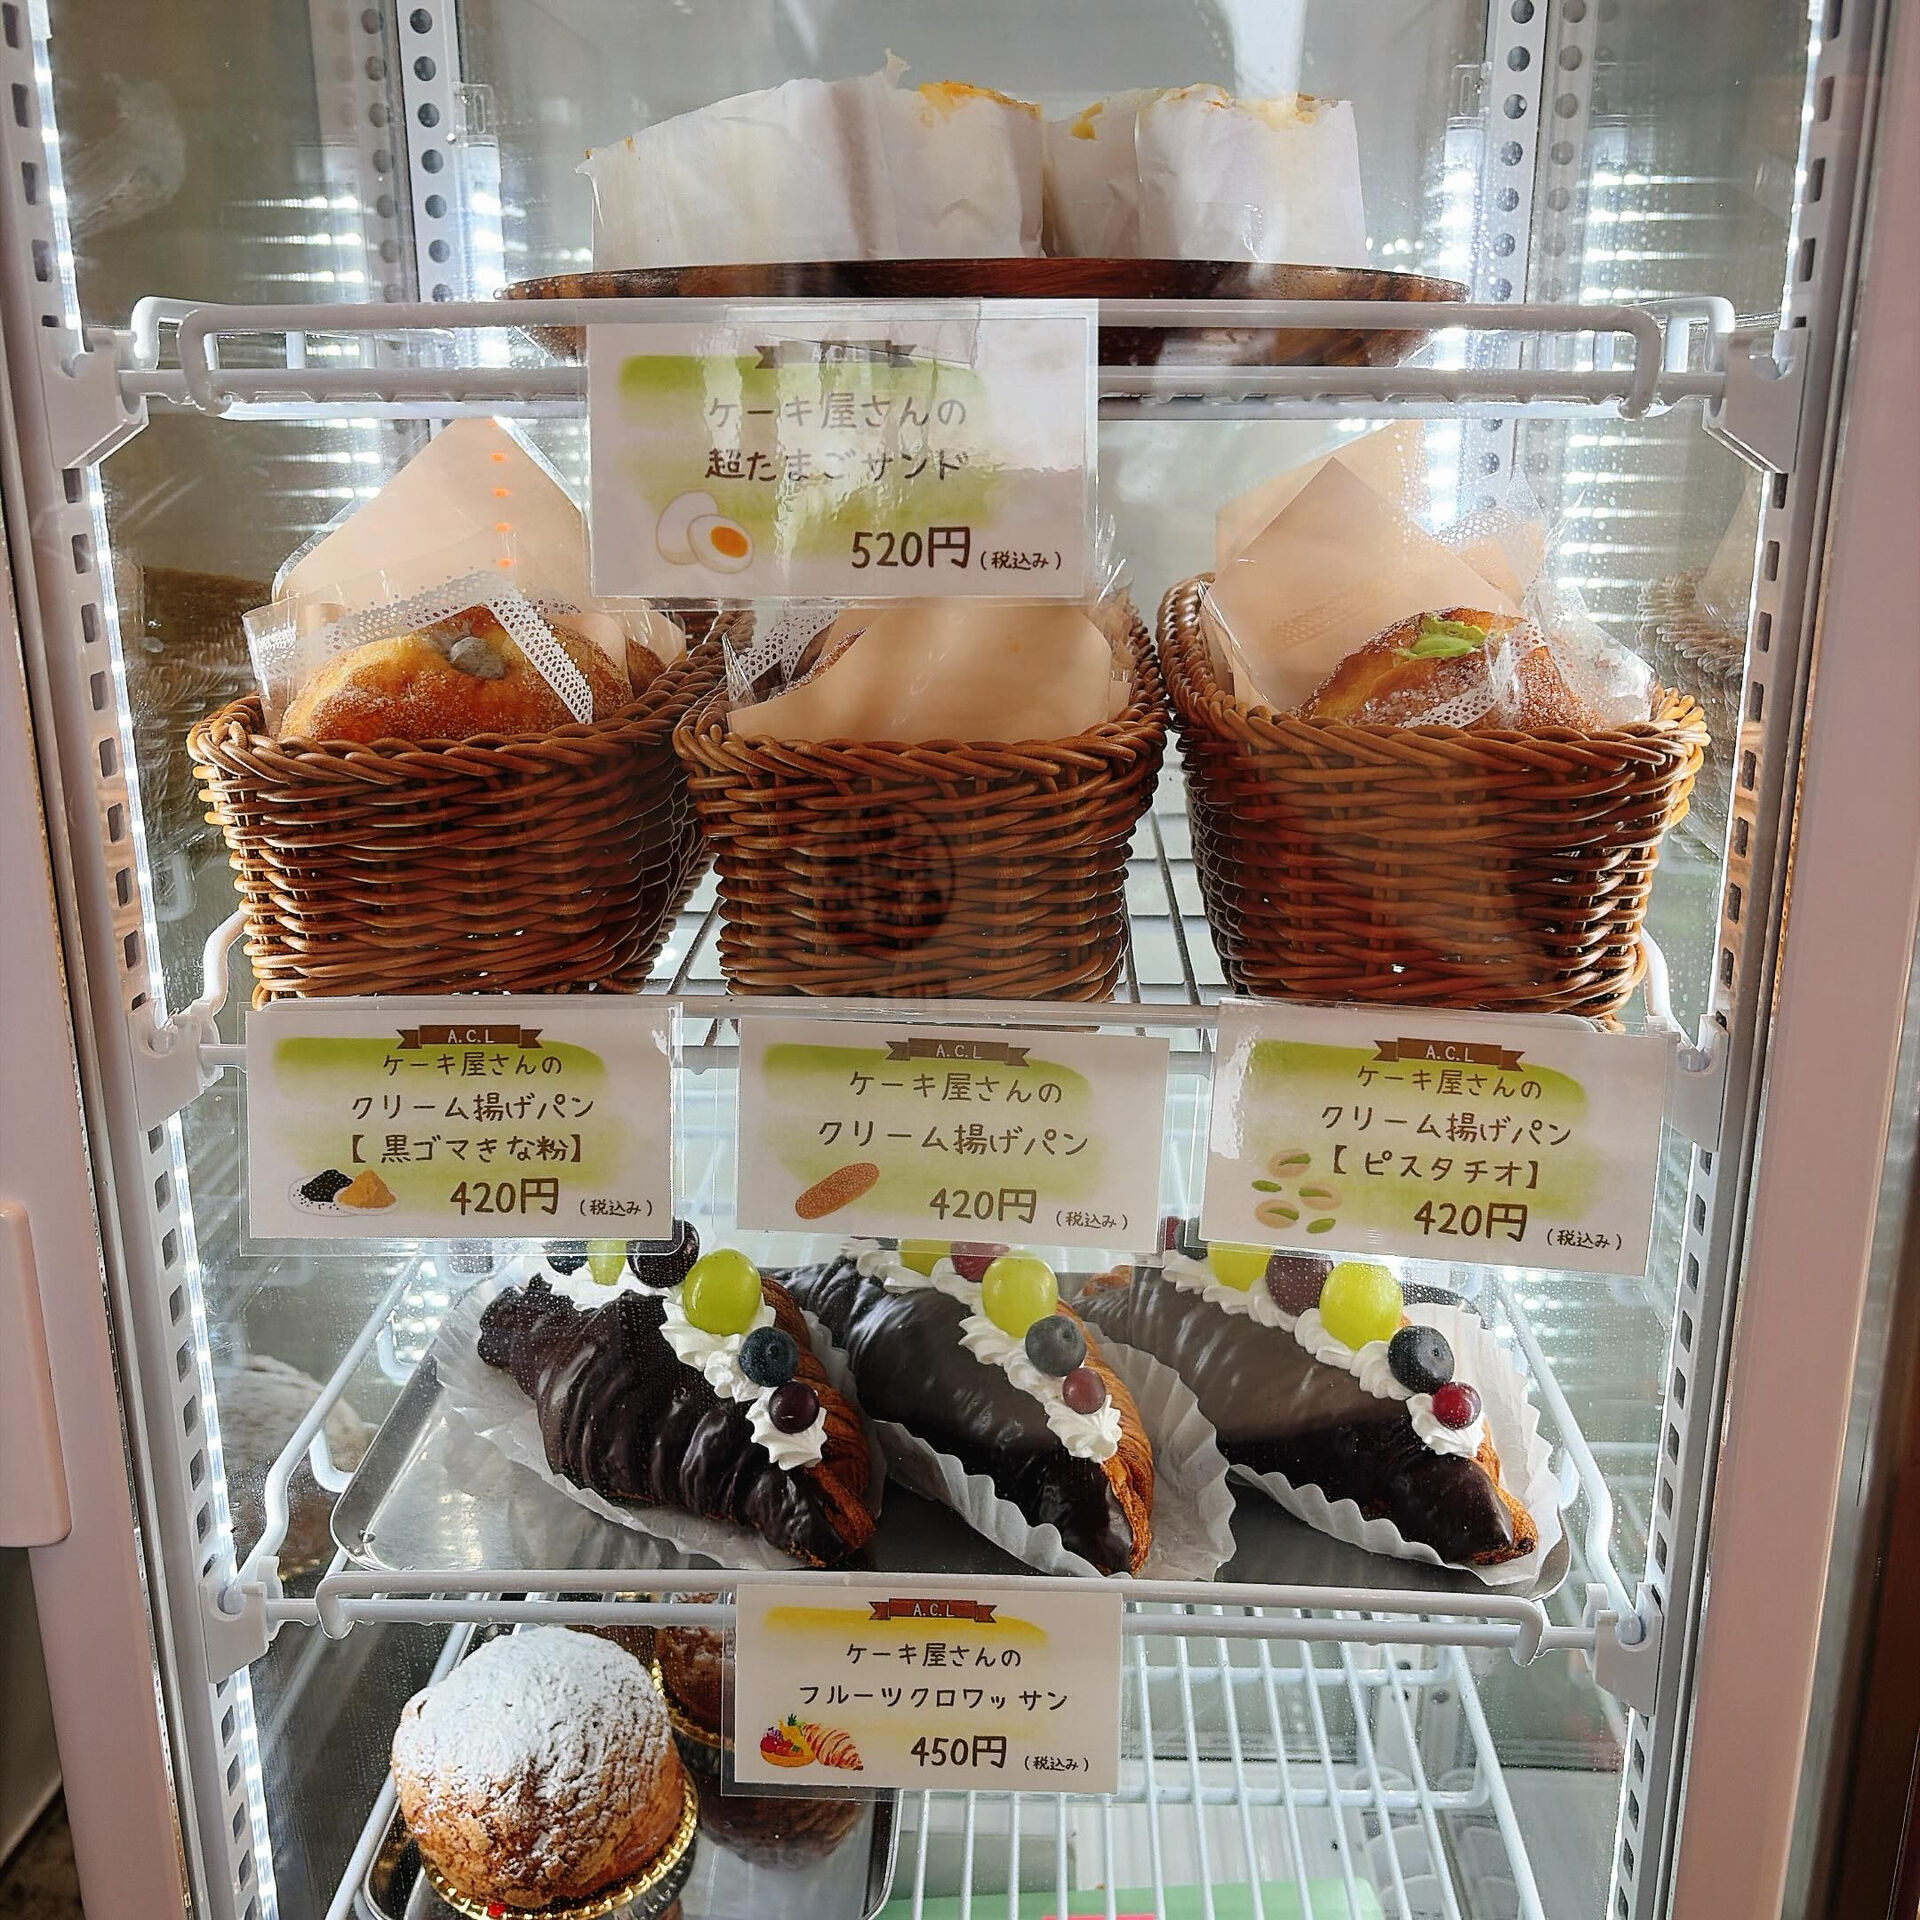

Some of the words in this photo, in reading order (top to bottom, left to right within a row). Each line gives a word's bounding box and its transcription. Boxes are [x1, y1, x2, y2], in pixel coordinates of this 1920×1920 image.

[708, 390, 967, 430] ケーキ屋さんの
[704, 447, 970, 482] 超たまごサンド
[851, 525, 971, 570] 520円
[980, 549, 1062, 571] (税込み)
[447, 1029, 495, 1044] A.C.L
[935, 1043, 983, 1060] A.C.L
[1425, 1045, 1476, 1063] A.C.L
[382, 1050, 562, 1077] ケーキ屋さんの
[849, 1070, 1062, 1104] ケーキ屋さんの
[1357, 1064, 1542, 1100] ケーキ屋さんの
[351, 1091, 595, 1122] クリーム揚げパン
[818, 1120, 1089, 1156] クリーム揚げパン
[1321, 1105, 1572, 1147] クリーム揚げパン
[352, 1133, 582, 1164] 【黒ゴマきな粉】
[1332, 1144, 1540, 1190] 【ピスタチオ】
[449, 1177, 560, 1217] 420円
[579, 1198, 653, 1217] (税込み)
[929, 1187, 1038, 1225] 420円
[1055, 1211, 1129, 1231] (税込み)
[1413, 1199, 1528, 1243] 420円
[1546, 1228, 1623, 1252] (税込み)
[912, 1603, 955, 1618] A.C.L
[845, 1642, 1022, 1668] ケーキ屋さんの
[799, 1684, 1069, 1712] フルーツクロワッサン
[910, 1734, 1008, 1769] 450円
[1024, 1755, 1090, 1773] (税込み)
